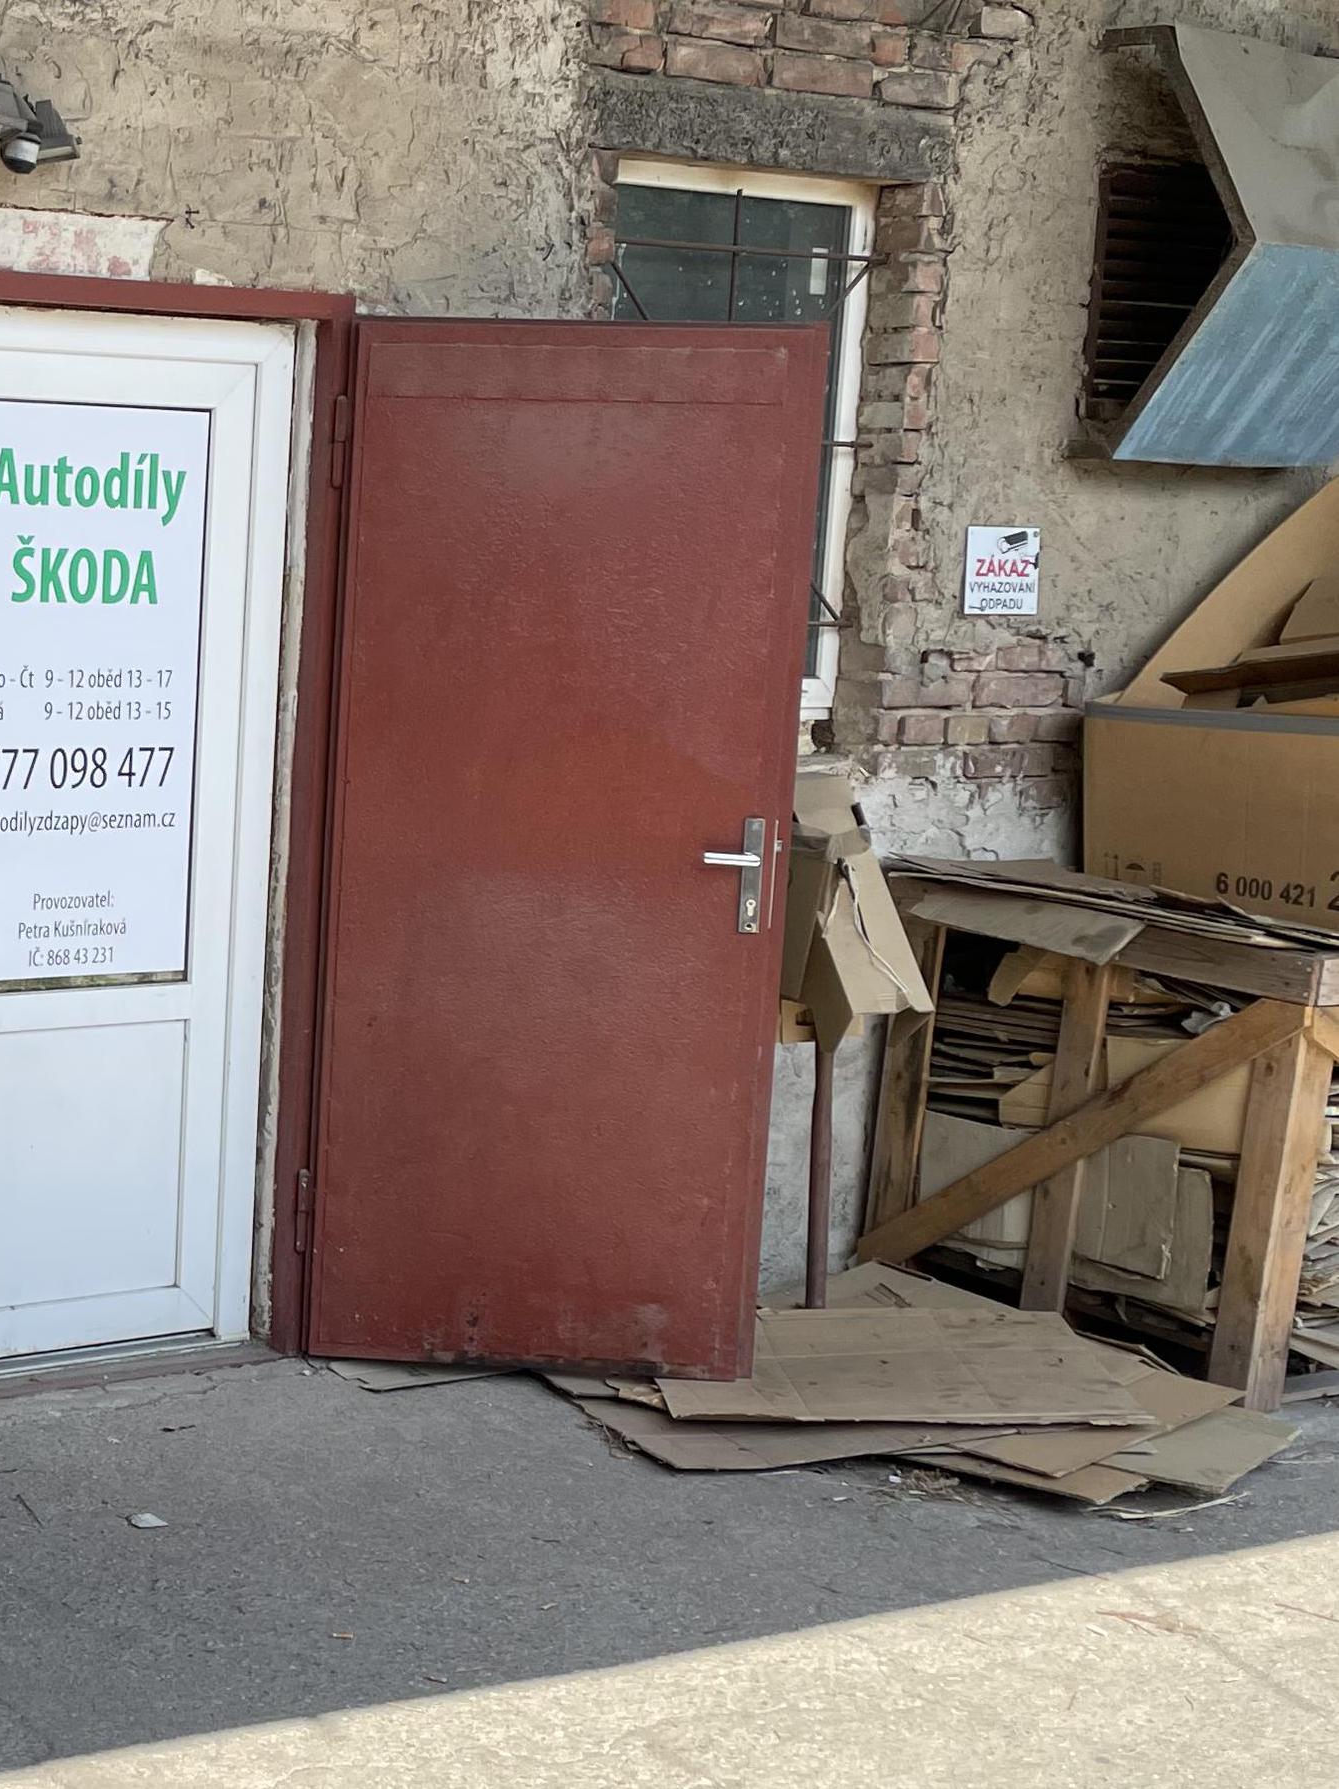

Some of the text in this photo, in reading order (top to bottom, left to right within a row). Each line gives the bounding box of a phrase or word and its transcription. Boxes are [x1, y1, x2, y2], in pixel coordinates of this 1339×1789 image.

[10, 534, 159, 605] ŠKODA
[975, 554, 1030, 577] ZÁKAZ
[980, 597, 1024, 611] ODPADU
[19, 664, 35, 688] Čt
[44, 669, 54, 688] 9
[68, 669, 85, 688] 12
[88, 667, 123, 688] oběd
[127, 669, 142, 688] 13
[157, 669, 173, 688] 17
[44, 701, 53, 721] 9
[67, 701, 84, 721] 12
[87, 700, 122, 720] oběd
[126, 701, 142, 720] 13
[156, 701, 172, 720] 15
[49, 747, 108, 789] 098
[117, 746, 175, 788] 477
[32, 890, 115, 911] Provozovatel:
[1215, 871, 1230, 896] 6
[1235, 876, 1273, 901] 000
[1279, 882, 1316, 908] 421
[18, 921, 50, 939] Petra
[28, 946, 114, 967] IČ: 868 43 231
